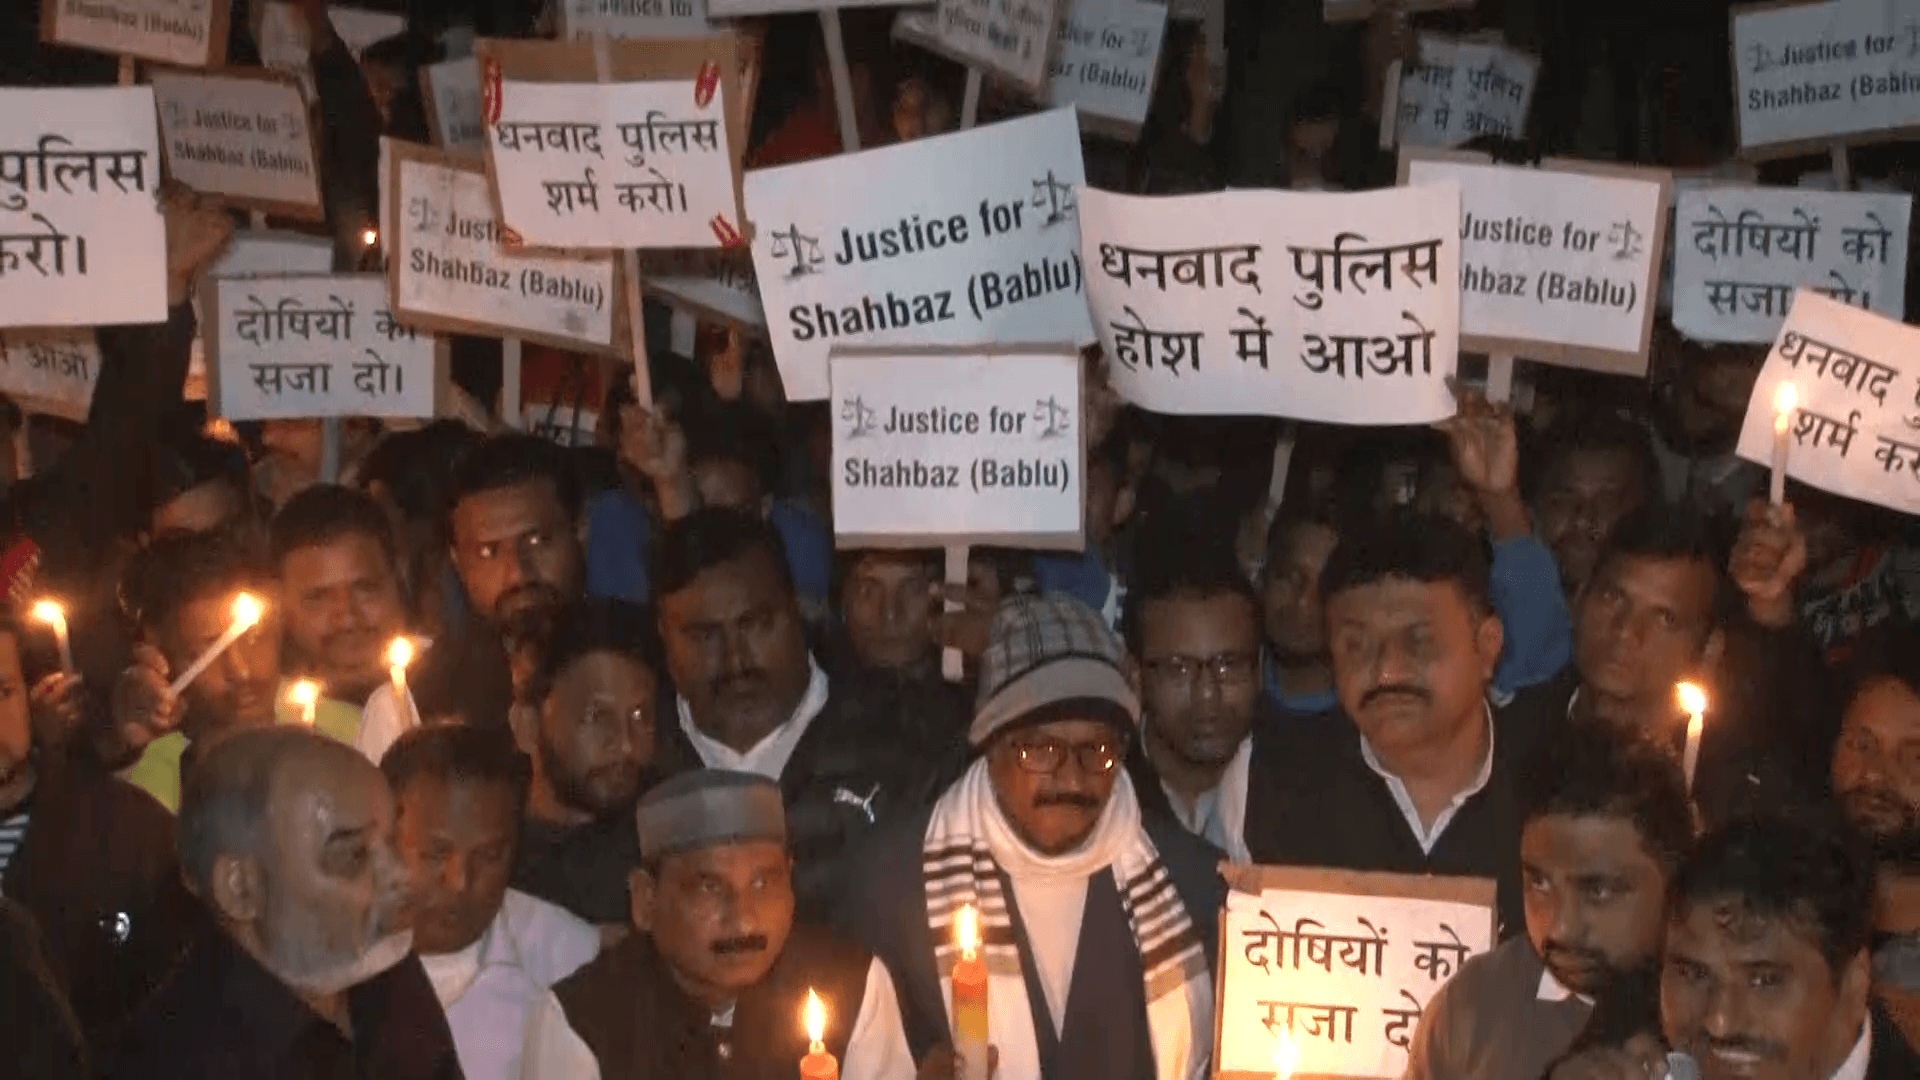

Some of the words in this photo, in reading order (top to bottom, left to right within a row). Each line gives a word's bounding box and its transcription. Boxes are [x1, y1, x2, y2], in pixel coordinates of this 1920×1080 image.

[1780, 38, 1858, 66] Justice
[1865, 33, 1895, 56] for
[1080, 62, 1146, 95] (Bablu)
[1748, 82, 1841, 111] Shahbaz
[616, 110, 719, 167] पुलिस
[541, 167, 599, 216] शर्म
[614, 168, 689, 213] करो।
[835, 214, 970, 266] Justice
[978, 198, 1024, 237] for
[1460, 212, 1553, 247] Justice
[1563, 220, 1600, 252] for
[1692, 205, 1821, 263] दोषियों
[1841, 211, 1893, 265] को
[410, 248, 511, 290] Shahbaz
[521, 268, 605, 311] (Bablu)
[789, 290, 955, 341] Shahbaz
[967, 250, 1082, 321] (Bablu)
[1287, 231, 1444, 311] पुलिस
[1459, 262, 1528, 297] hbaz
[1537, 270, 1637, 314] (Bablu)
[234, 294, 355, 348] दोषियों
[1110, 305, 1205, 377] होश
[1229, 306, 1273, 370] में
[1300, 311, 1436, 379] आओ
[249, 363, 333, 395] सजा
[353, 348, 404, 398] दो।
[883, 405, 980, 434] Justice
[990, 405, 1027, 434] for
[1793, 408, 1862, 459] शर्म
[844, 458, 960, 488] Shahbaz
[970, 458, 1070, 494] (Bablu)
[1242, 909, 1388, 977] दोषियों
